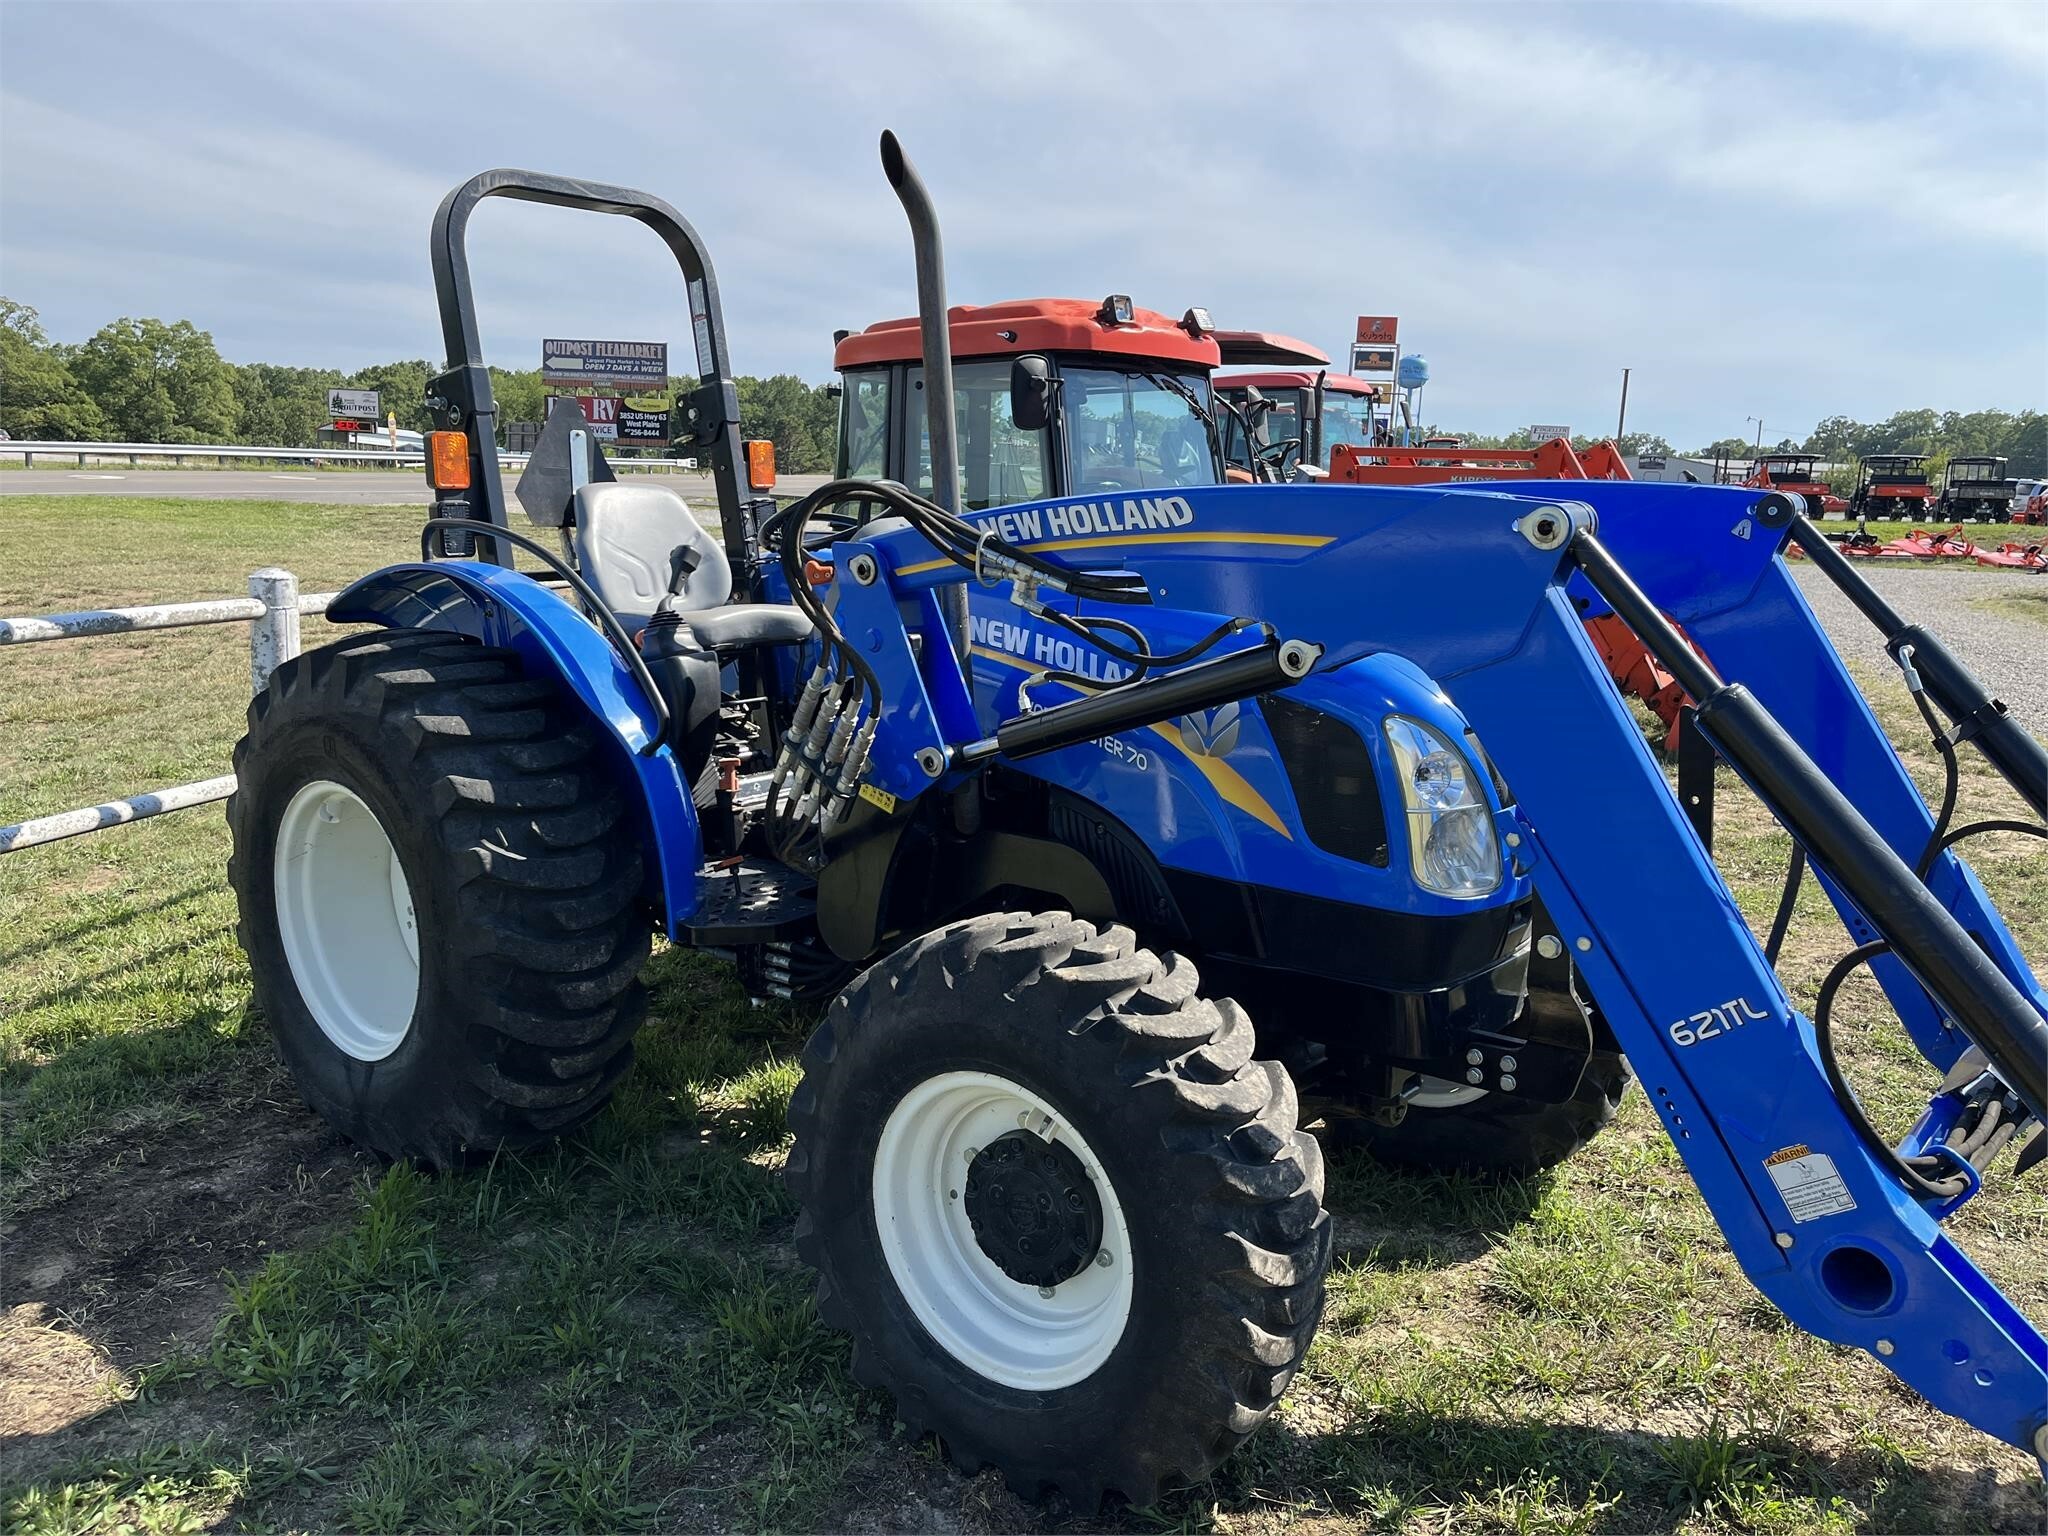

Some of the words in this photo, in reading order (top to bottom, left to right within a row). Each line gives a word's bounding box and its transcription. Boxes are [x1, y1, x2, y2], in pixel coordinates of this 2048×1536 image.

[1359, 331, 1393, 341] Kubota
[545, 341, 594, 356] OUTPOST
[595, 342, 664, 359] FLEAMARKET
[612, 364, 632, 372] DAYS
[342, 404, 377, 412] OUTPOST
[592, 398, 618, 420] RV
[619, 411, 635, 420] 3852
[634, 412, 644, 420] US
[644, 412, 658, 421] Hwy
[658, 413, 667, 421] 63
[590, 425, 612, 434] RVICE
[642, 420, 660, 428] Plains
[977, 509, 1044, 543] NEW
[1045, 496, 1194, 537] HOLLAND
[970, 615, 1030, 655] NEW
[1035, 633, 1135, 681] HOLLA
[1126, 746, 1148, 771] 70
[1669, 997, 1768, 1046] 621TL
[1774, 1146, 1809, 1161] WARNI
